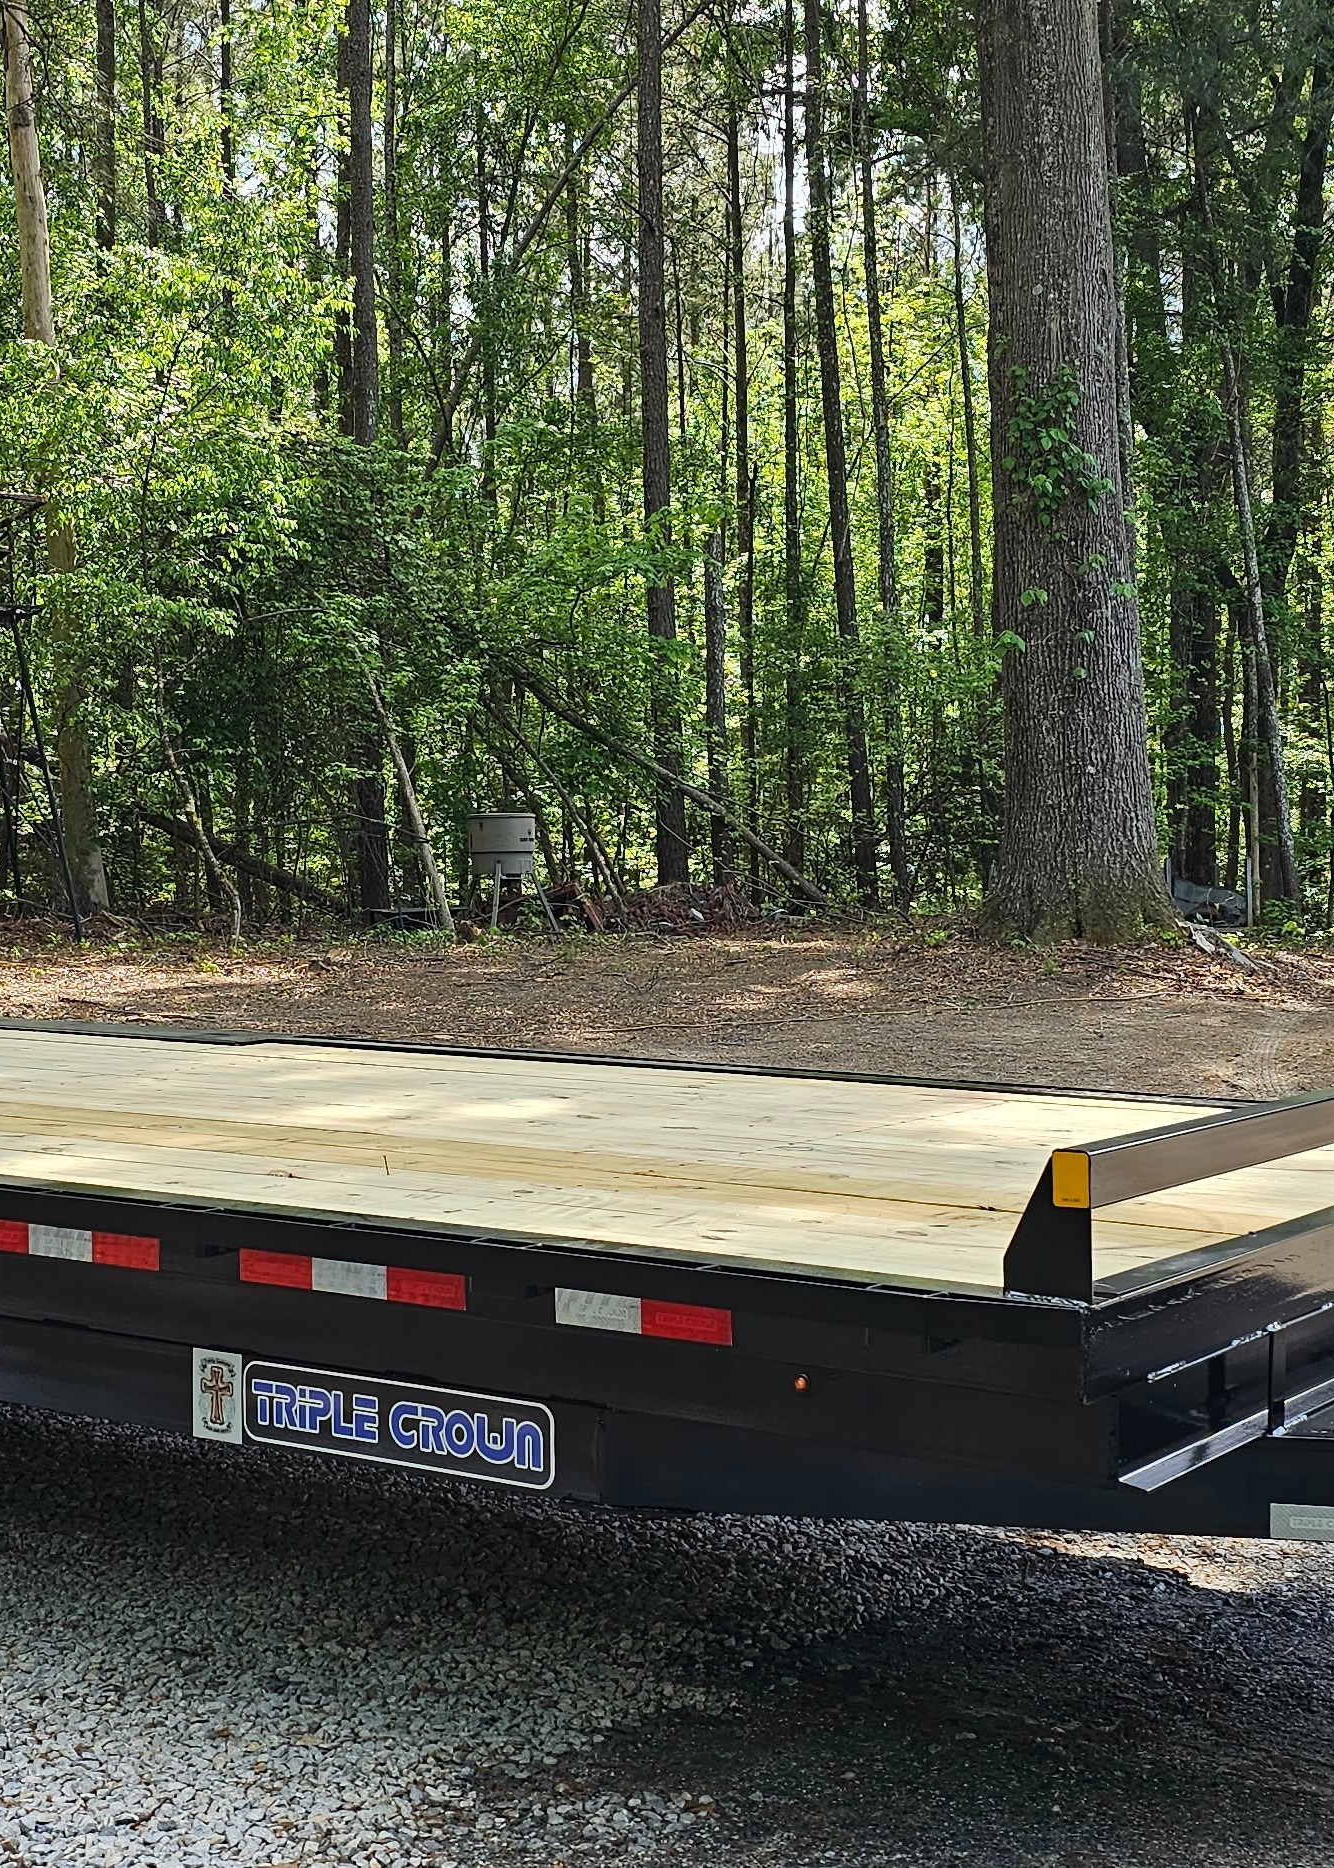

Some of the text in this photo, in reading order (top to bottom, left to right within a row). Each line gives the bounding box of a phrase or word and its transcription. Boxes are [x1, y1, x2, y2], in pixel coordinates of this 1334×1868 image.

[251, 1378, 544, 1473] TRIPLE CROWN
[1292, 1518, 1324, 1528] TRIPLE
